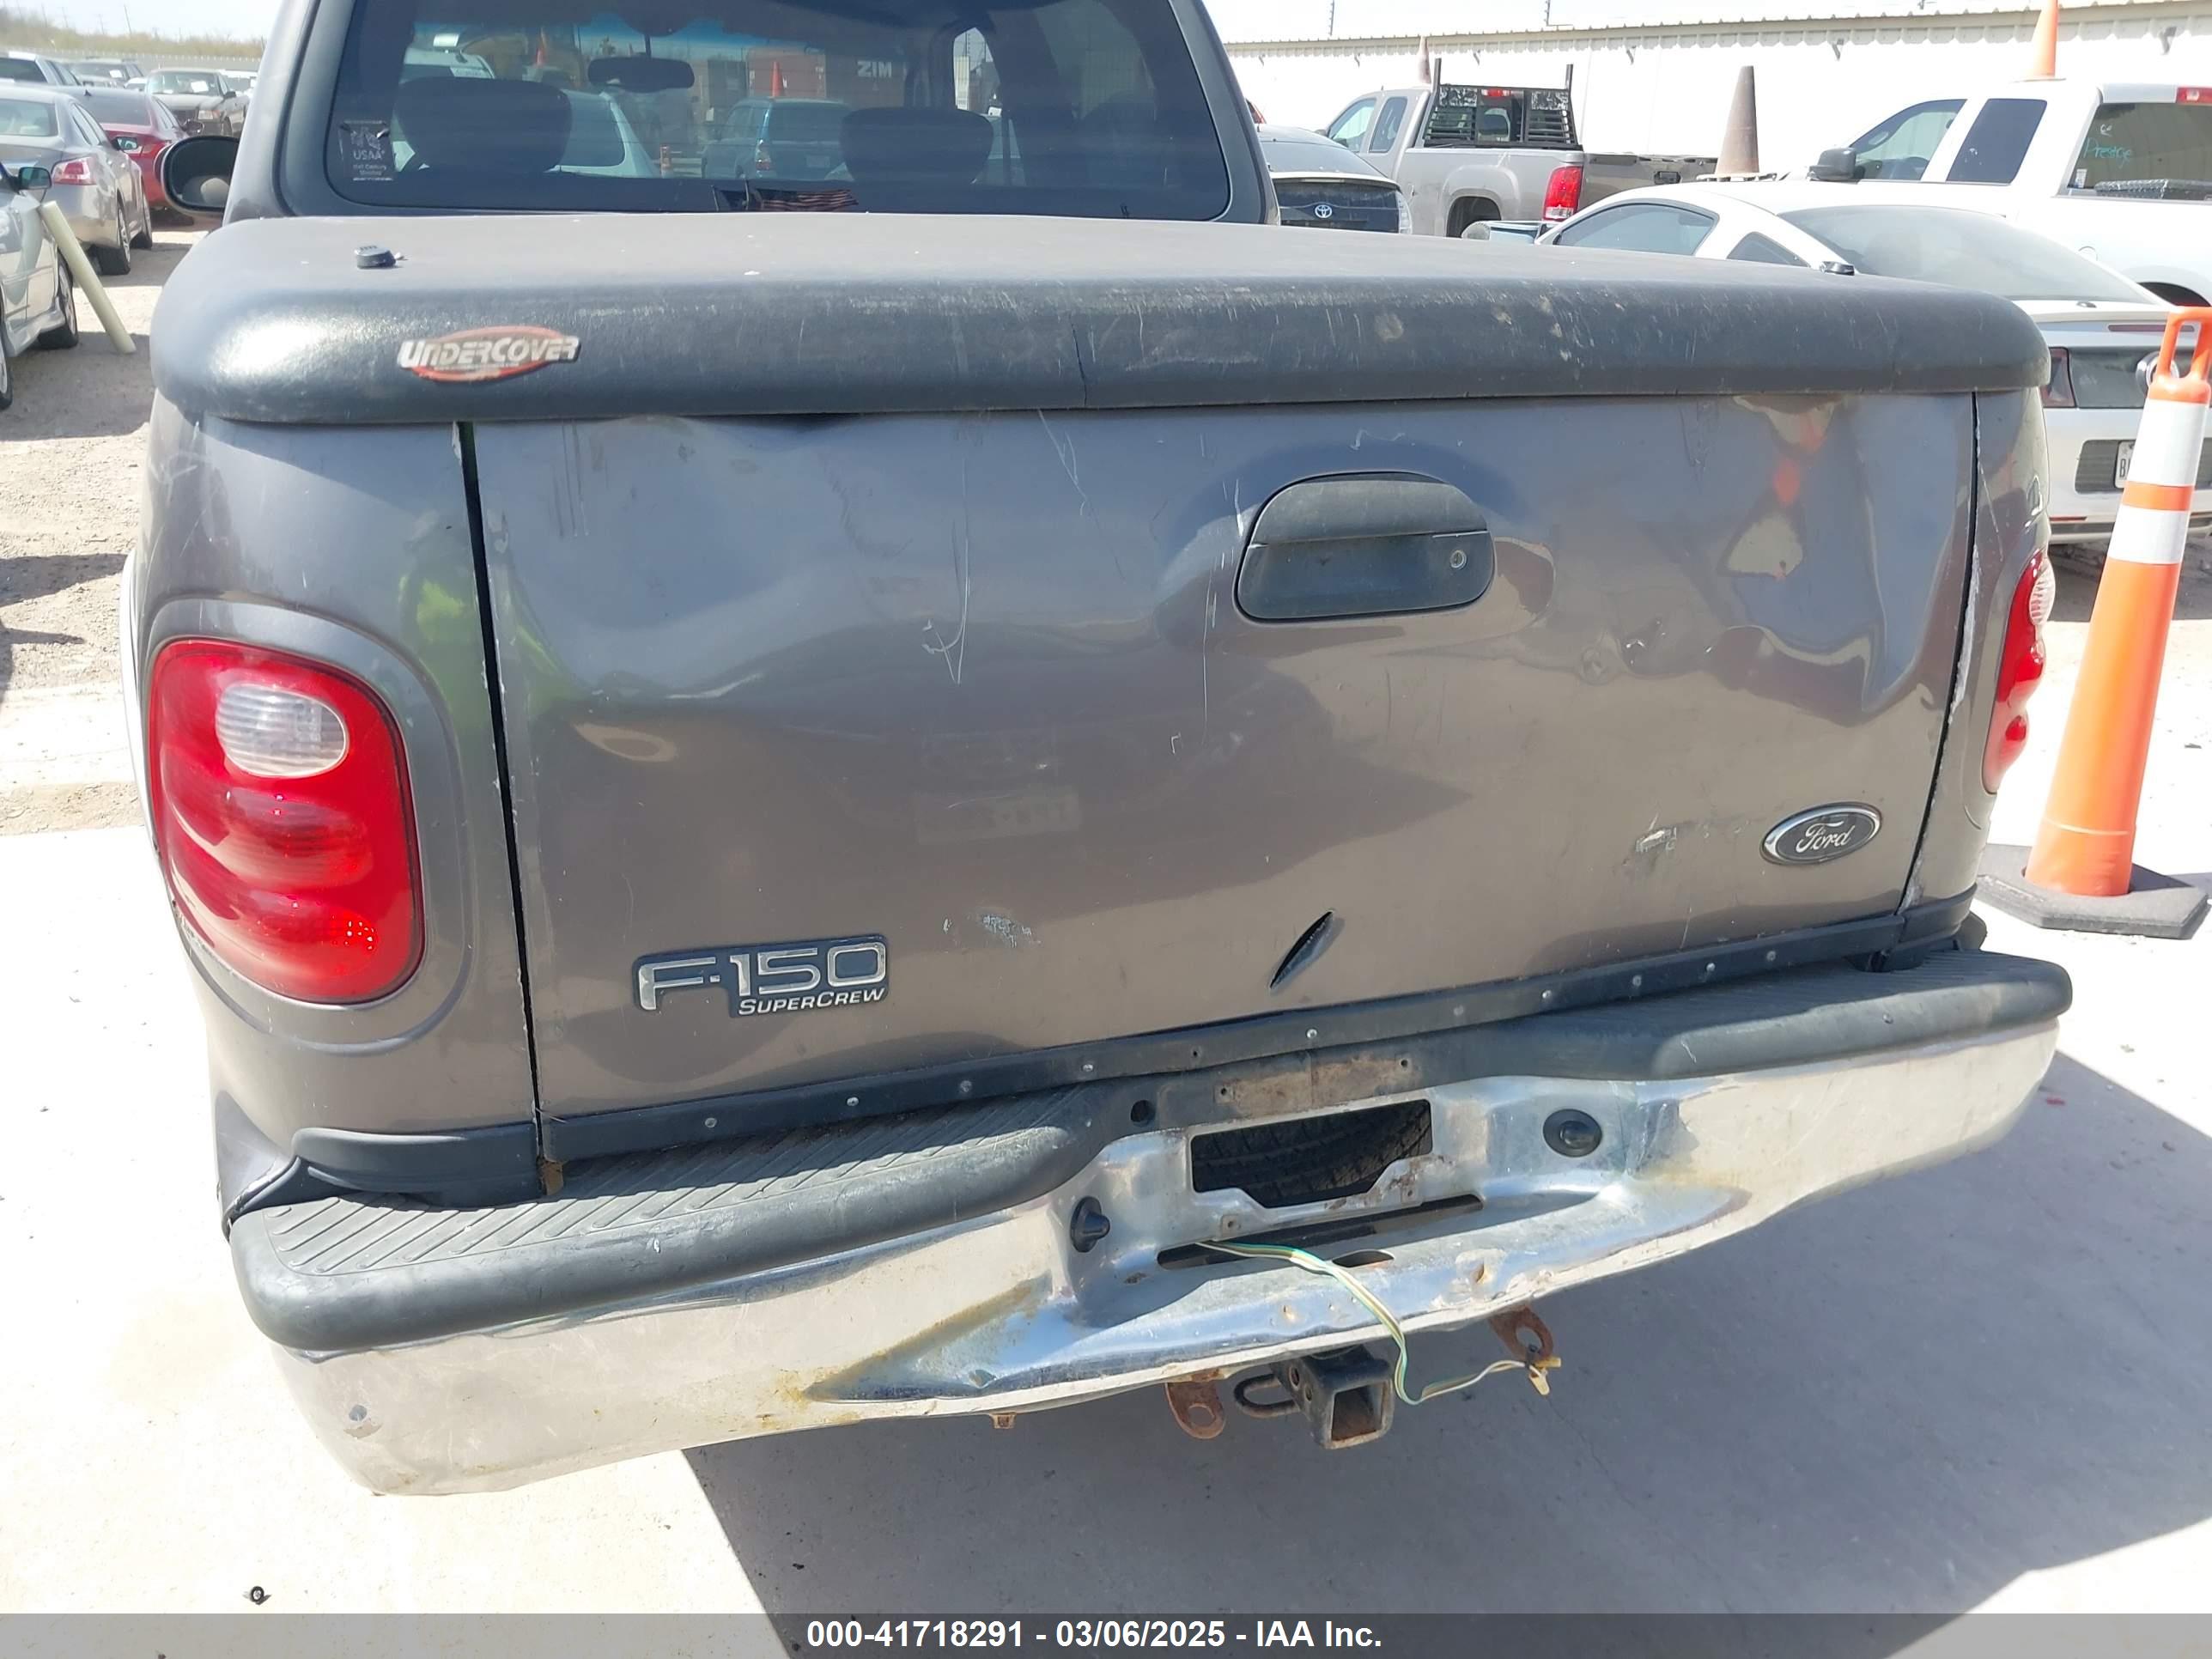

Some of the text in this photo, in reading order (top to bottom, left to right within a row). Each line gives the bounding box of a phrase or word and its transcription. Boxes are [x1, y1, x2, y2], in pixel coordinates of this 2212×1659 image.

[857, 60, 892, 78] ZIM
[1796, 820, 1855, 853] Ford
[638, 942, 886, 1011] F-150
